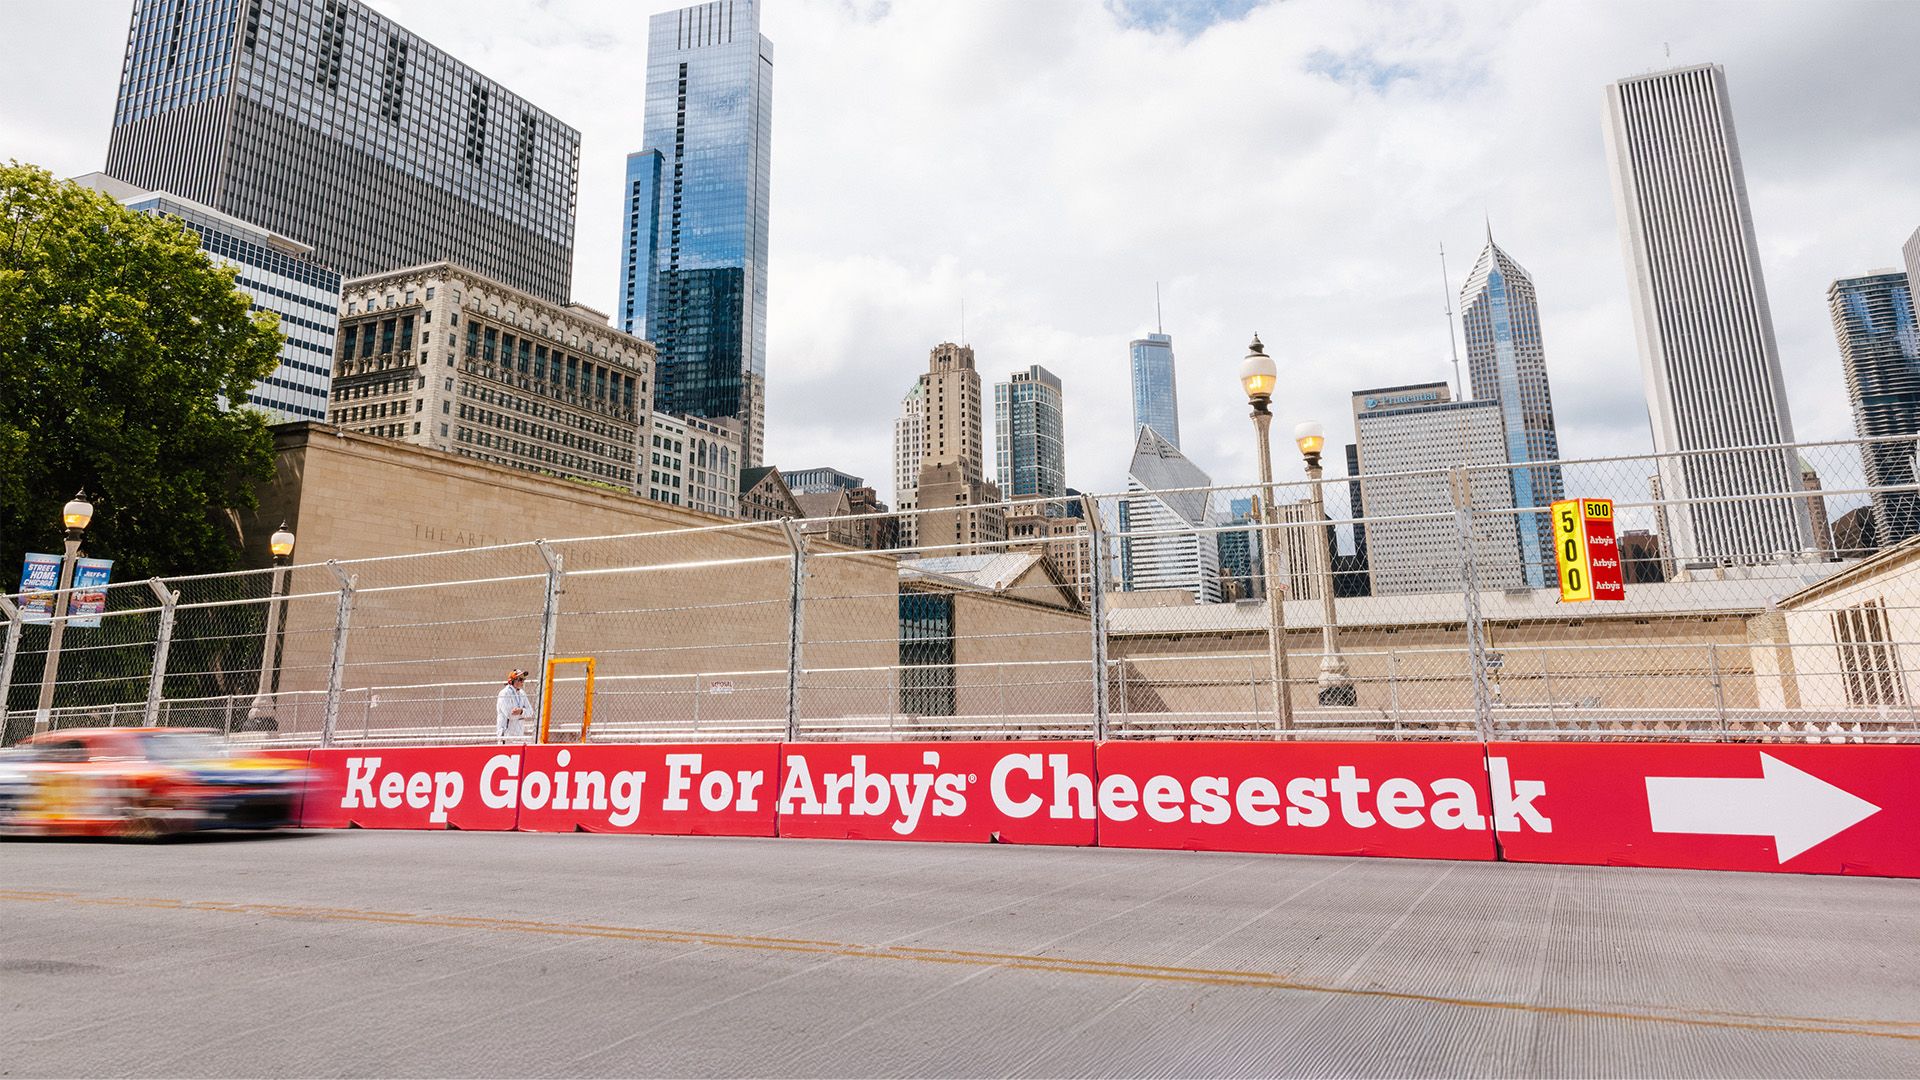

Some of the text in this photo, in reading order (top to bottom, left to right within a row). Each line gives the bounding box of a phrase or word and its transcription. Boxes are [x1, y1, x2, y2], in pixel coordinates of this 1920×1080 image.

[1382, 390, 1437, 405] Prudential
[1587, 504, 1608, 516] 500
[413, 524, 447, 541] THE
[455, 531, 485, 547] ART
[494, 537, 576, 561] INSTITE
[1590, 536, 1614, 546] Arby's
[28, 563, 55, 571] STREET
[1593, 558, 1617, 568] Arby's
[30, 571, 56, 580] HOME
[23, 579, 53, 587] CHICAGO
[1596, 581, 1620, 591] Arby's
[340, 757, 465, 824] Keep
[479, 749, 647, 828] Going
[662, 753, 764, 813] For
[990, 753, 1552, 833] Cheesesteak
